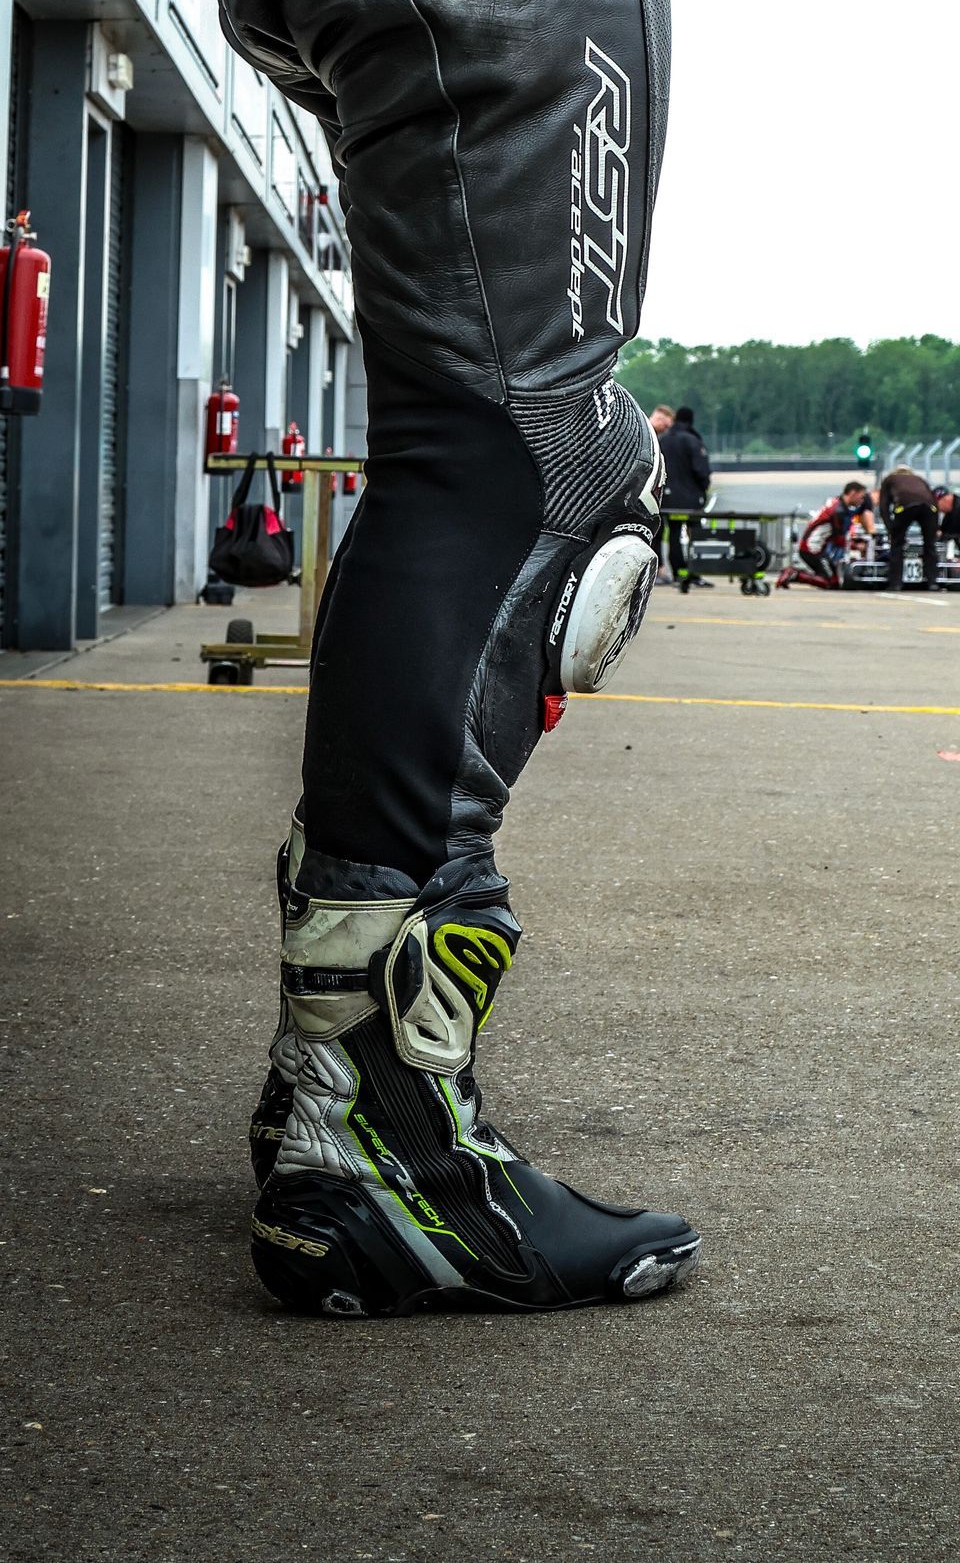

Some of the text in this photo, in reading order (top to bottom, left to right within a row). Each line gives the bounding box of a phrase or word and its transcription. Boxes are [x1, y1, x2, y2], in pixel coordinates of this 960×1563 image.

[566, 123, 586, 343] race dept
[584, 36, 631, 336] RST
[353, 1113, 390, 1157] SUPER
[412, 1191, 446, 1227] TECH
